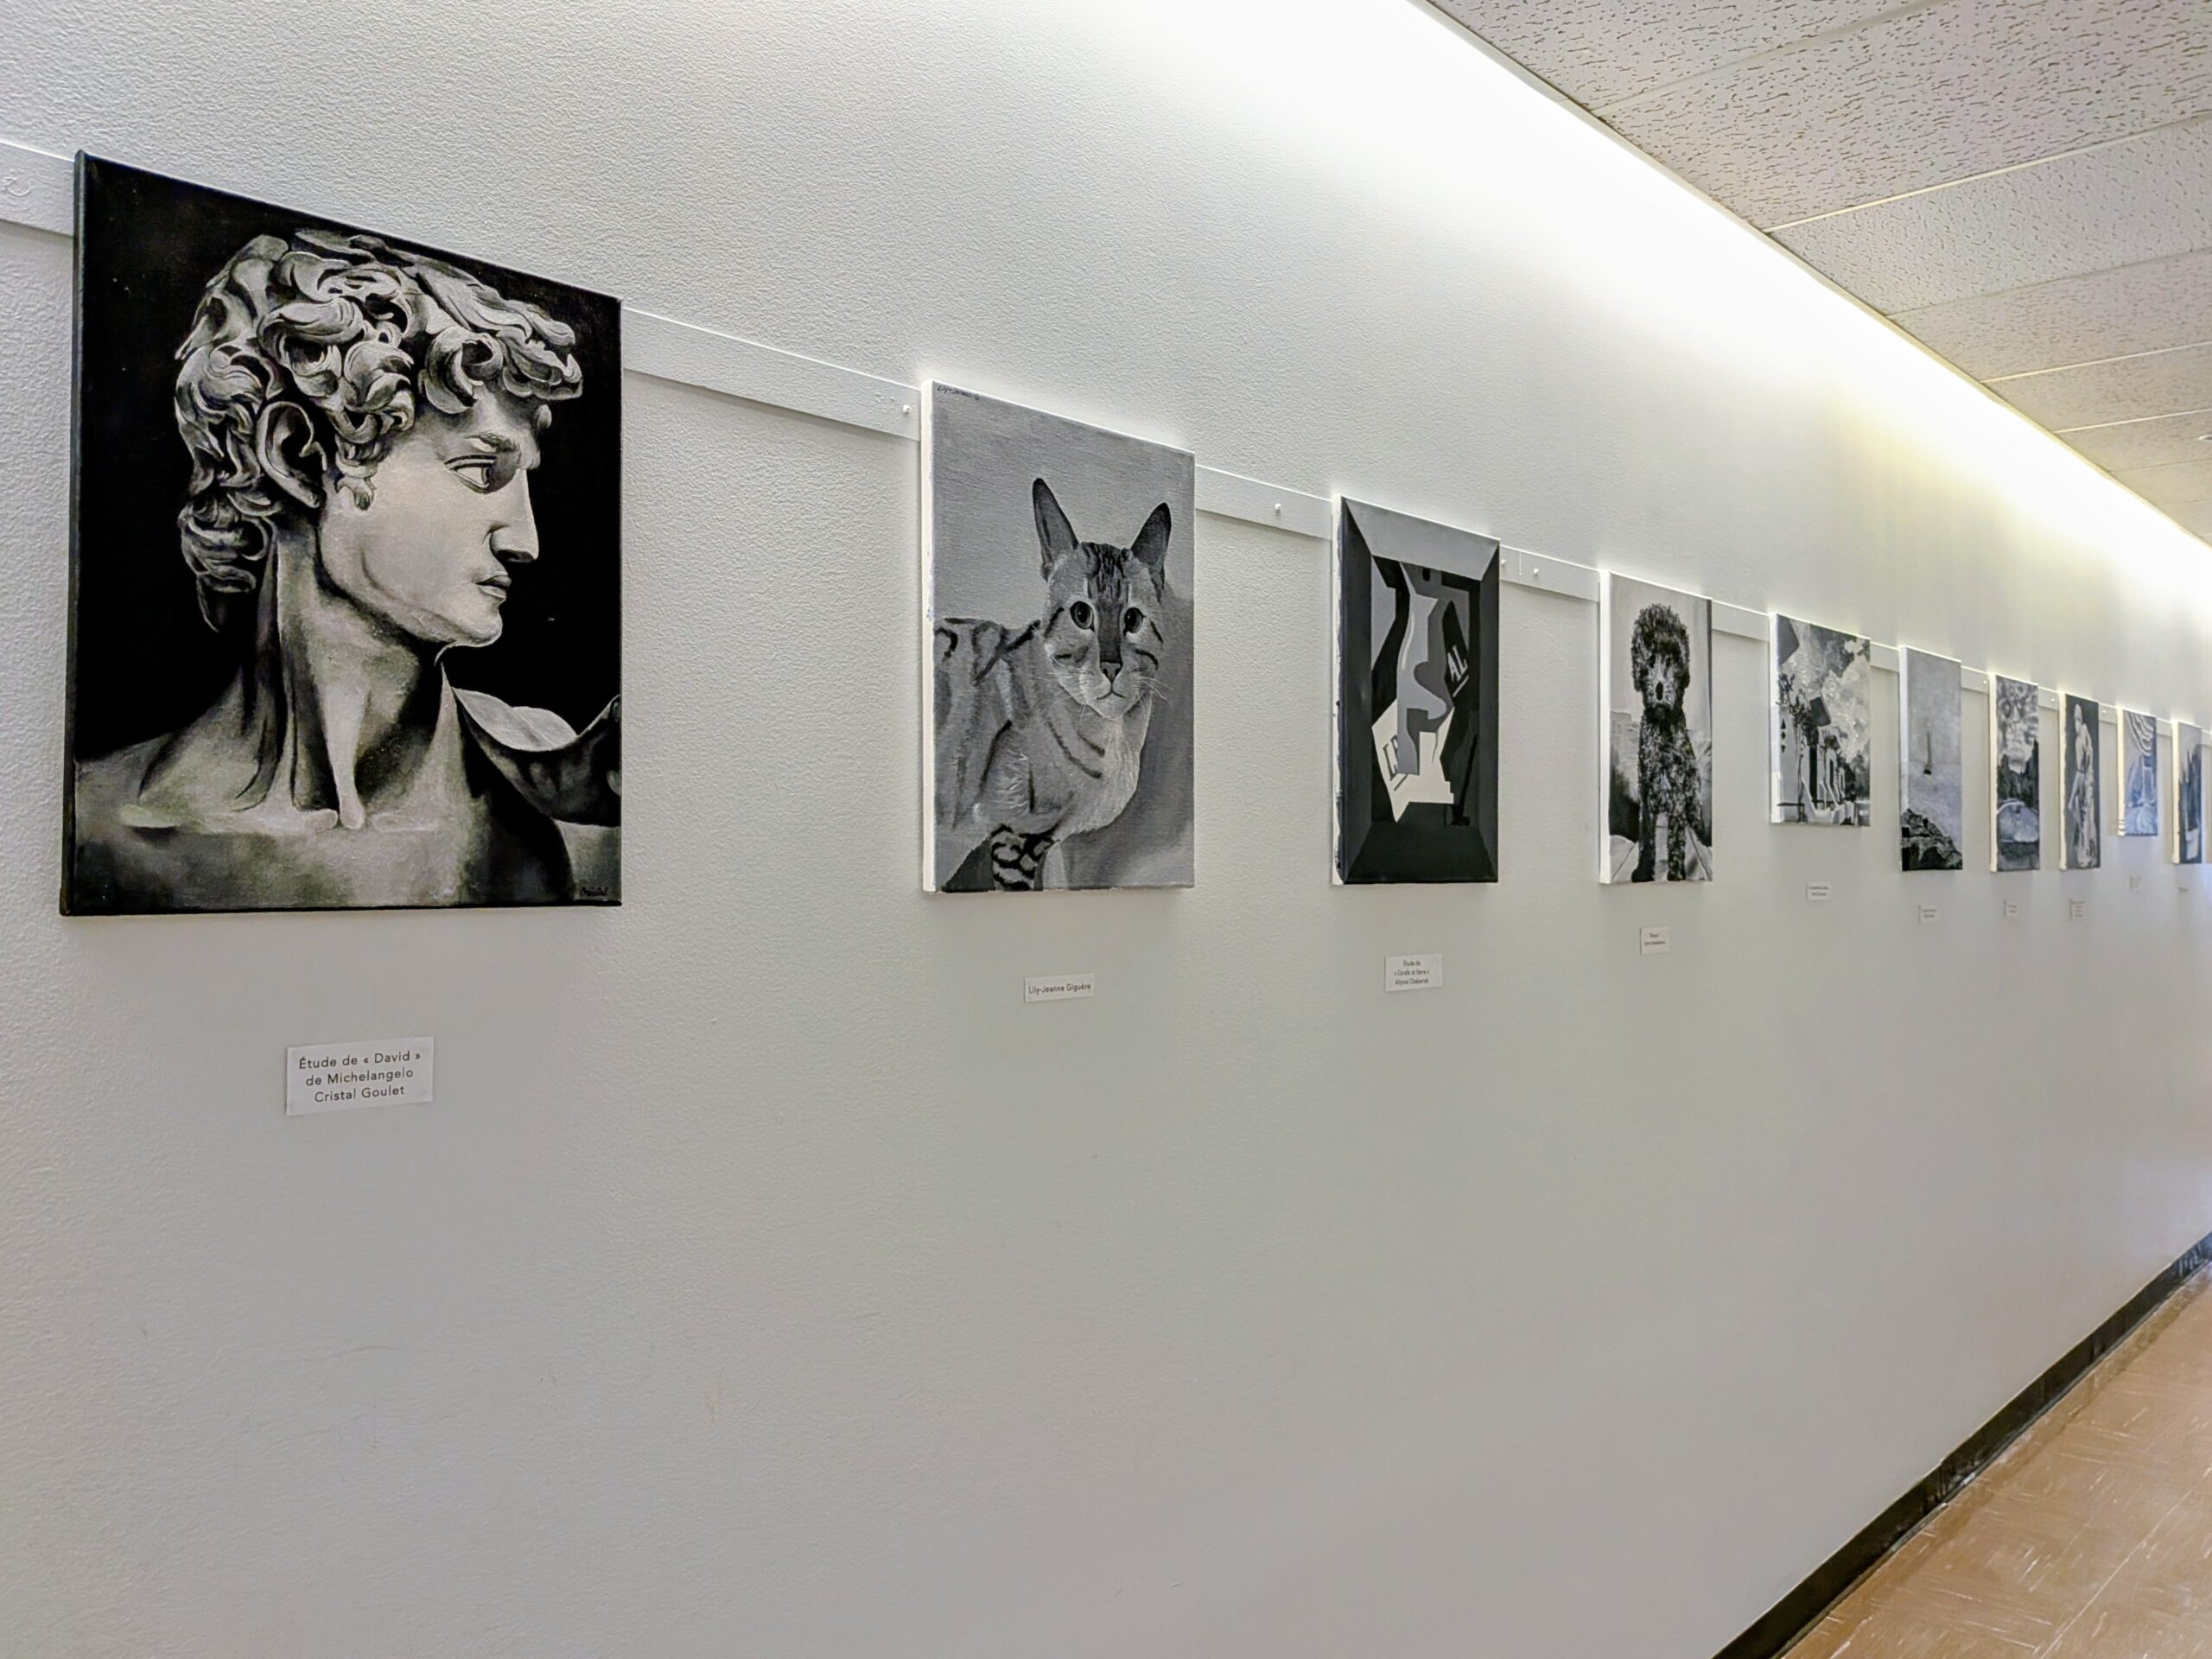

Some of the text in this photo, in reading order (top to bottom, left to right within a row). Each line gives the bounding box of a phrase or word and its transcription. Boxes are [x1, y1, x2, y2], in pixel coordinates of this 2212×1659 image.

[1447, 645, 1468, 683] AL
[1028, 982, 1091, 995] Lily-Jeanne Giguère
[299, 1056, 336, 1070] Étude
[342, 1055, 358, 1066] de
[374, 1050, 410, 1064] David
[306, 1067, 414, 1086] de Michelangelo
[315, 1085, 404, 1103] Cristal Goulet
